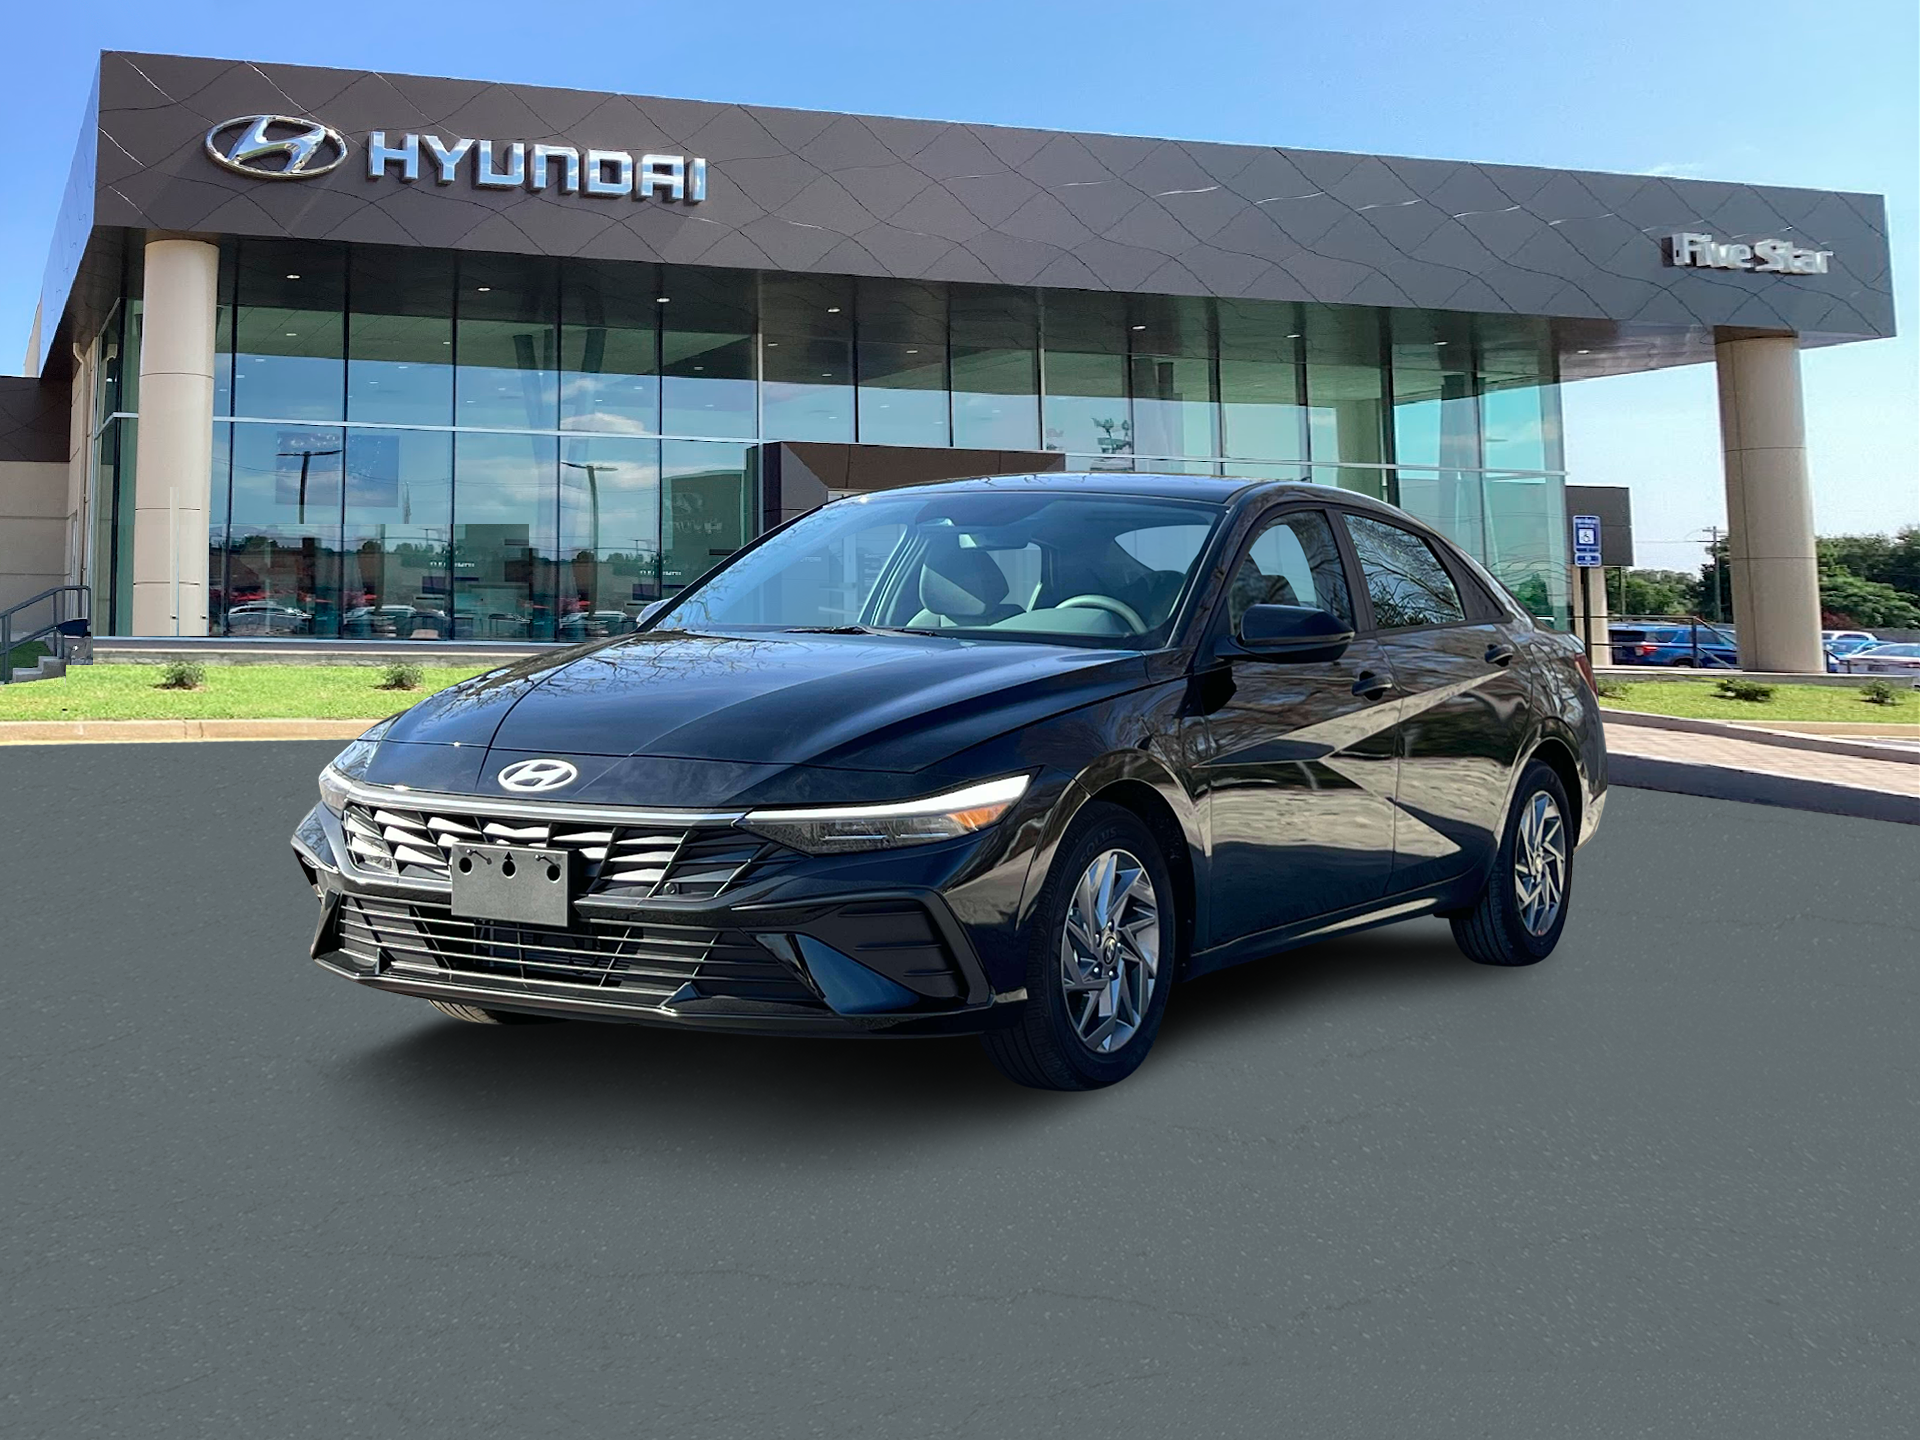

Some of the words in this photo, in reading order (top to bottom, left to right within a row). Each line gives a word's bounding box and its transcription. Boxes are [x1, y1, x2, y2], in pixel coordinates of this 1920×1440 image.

[367, 130, 707, 202] HYUNDAI
[1669, 232, 1756, 270] Five
[1754, 238, 1834, 274] Star
